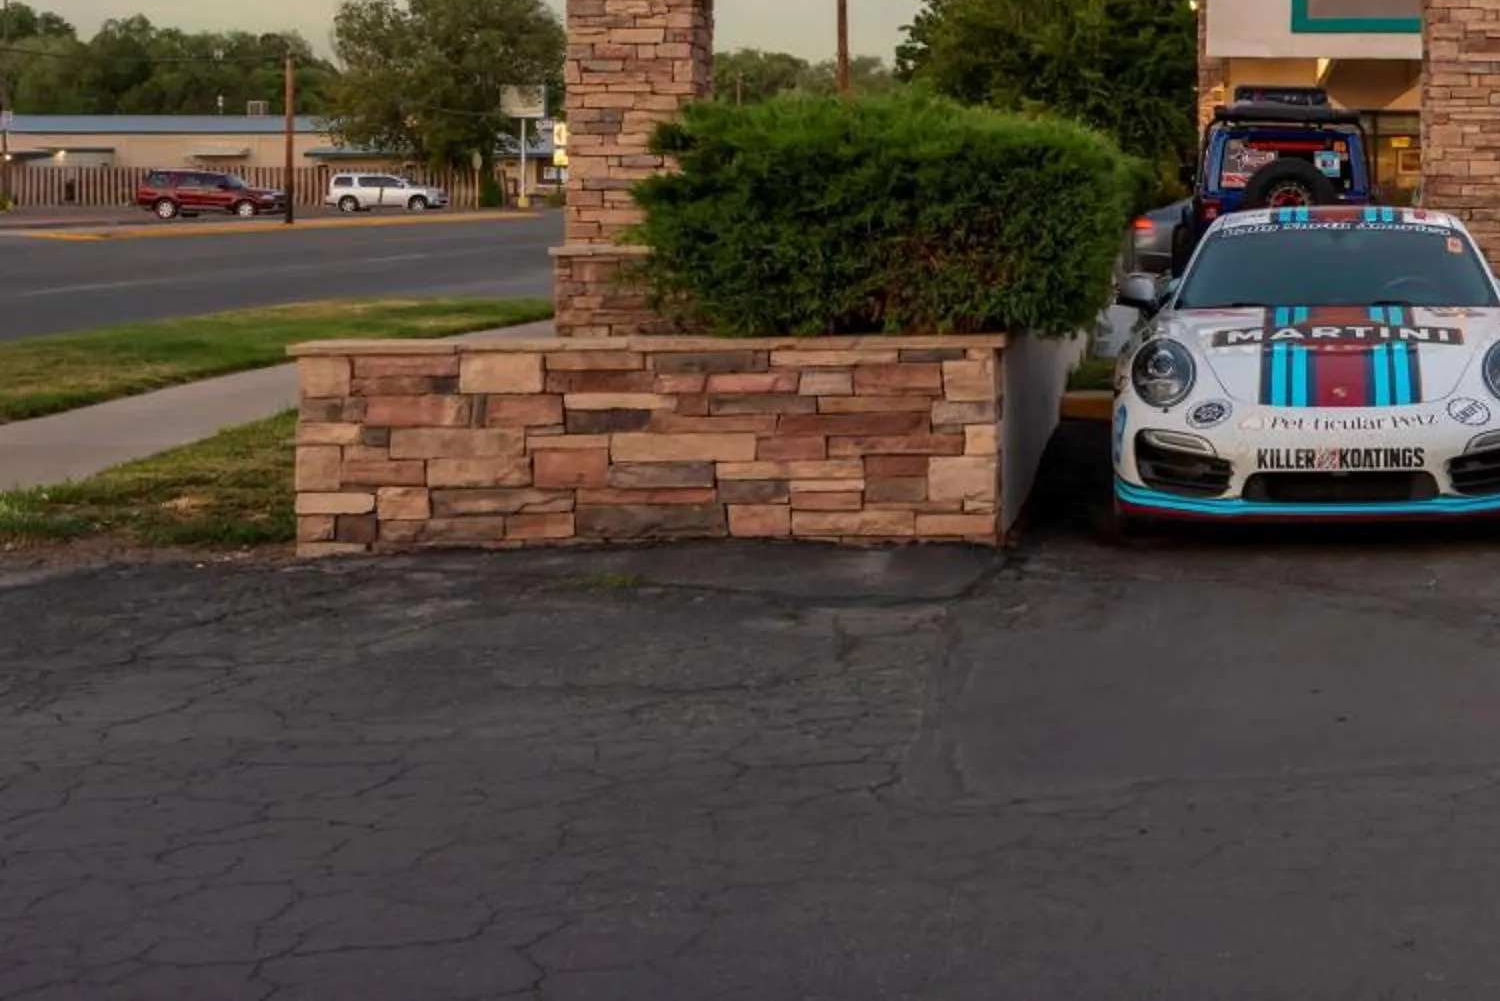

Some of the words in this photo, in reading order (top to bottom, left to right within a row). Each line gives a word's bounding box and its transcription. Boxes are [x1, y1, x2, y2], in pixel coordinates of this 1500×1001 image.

[1226, 326, 1449, 344] MARTINI
[1257, 448, 1316, 470] KILLER
[1338, 447, 1425, 470] KOATINGS
